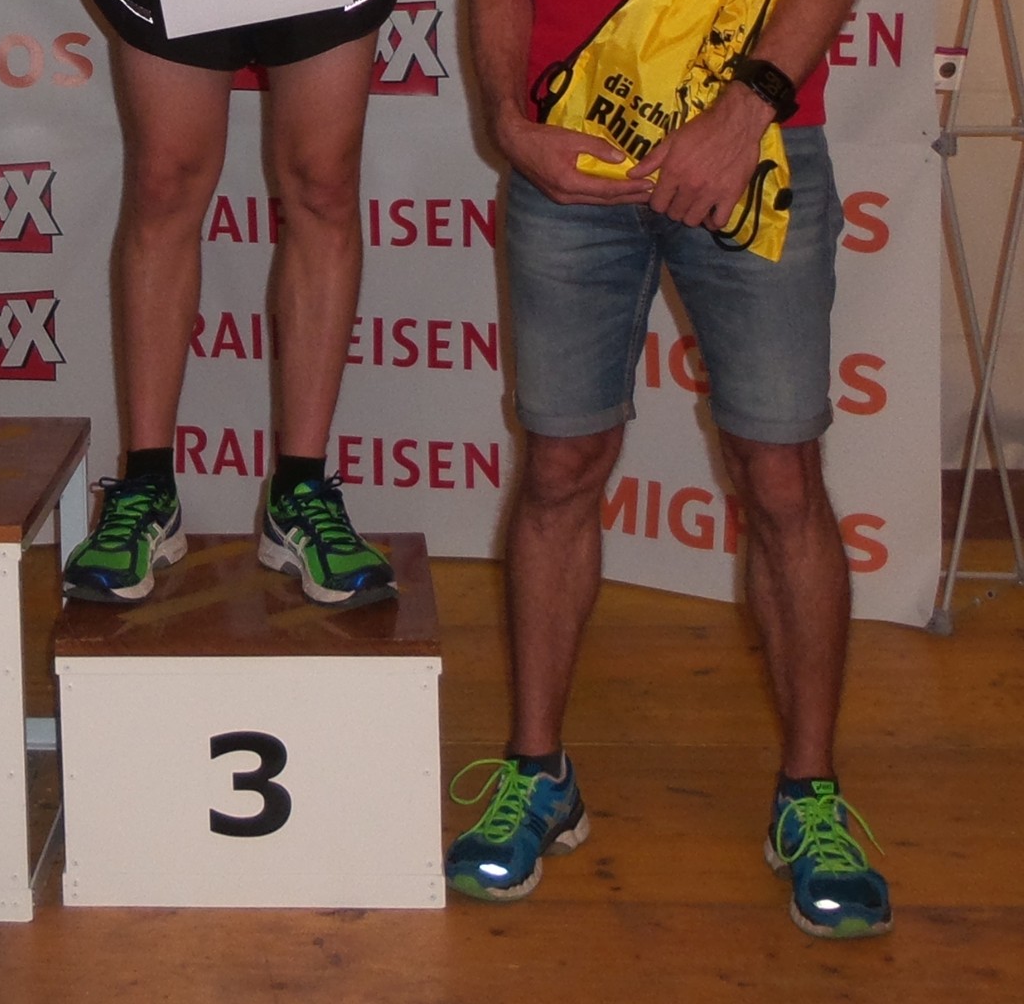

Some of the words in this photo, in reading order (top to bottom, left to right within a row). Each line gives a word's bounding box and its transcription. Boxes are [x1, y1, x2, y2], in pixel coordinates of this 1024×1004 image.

[604, 73, 633, 99] dä
[585, 94, 662, 161] Rhin
[176, 425, 501, 490] RAIEISEN
[209, 730, 292, 838] 3
